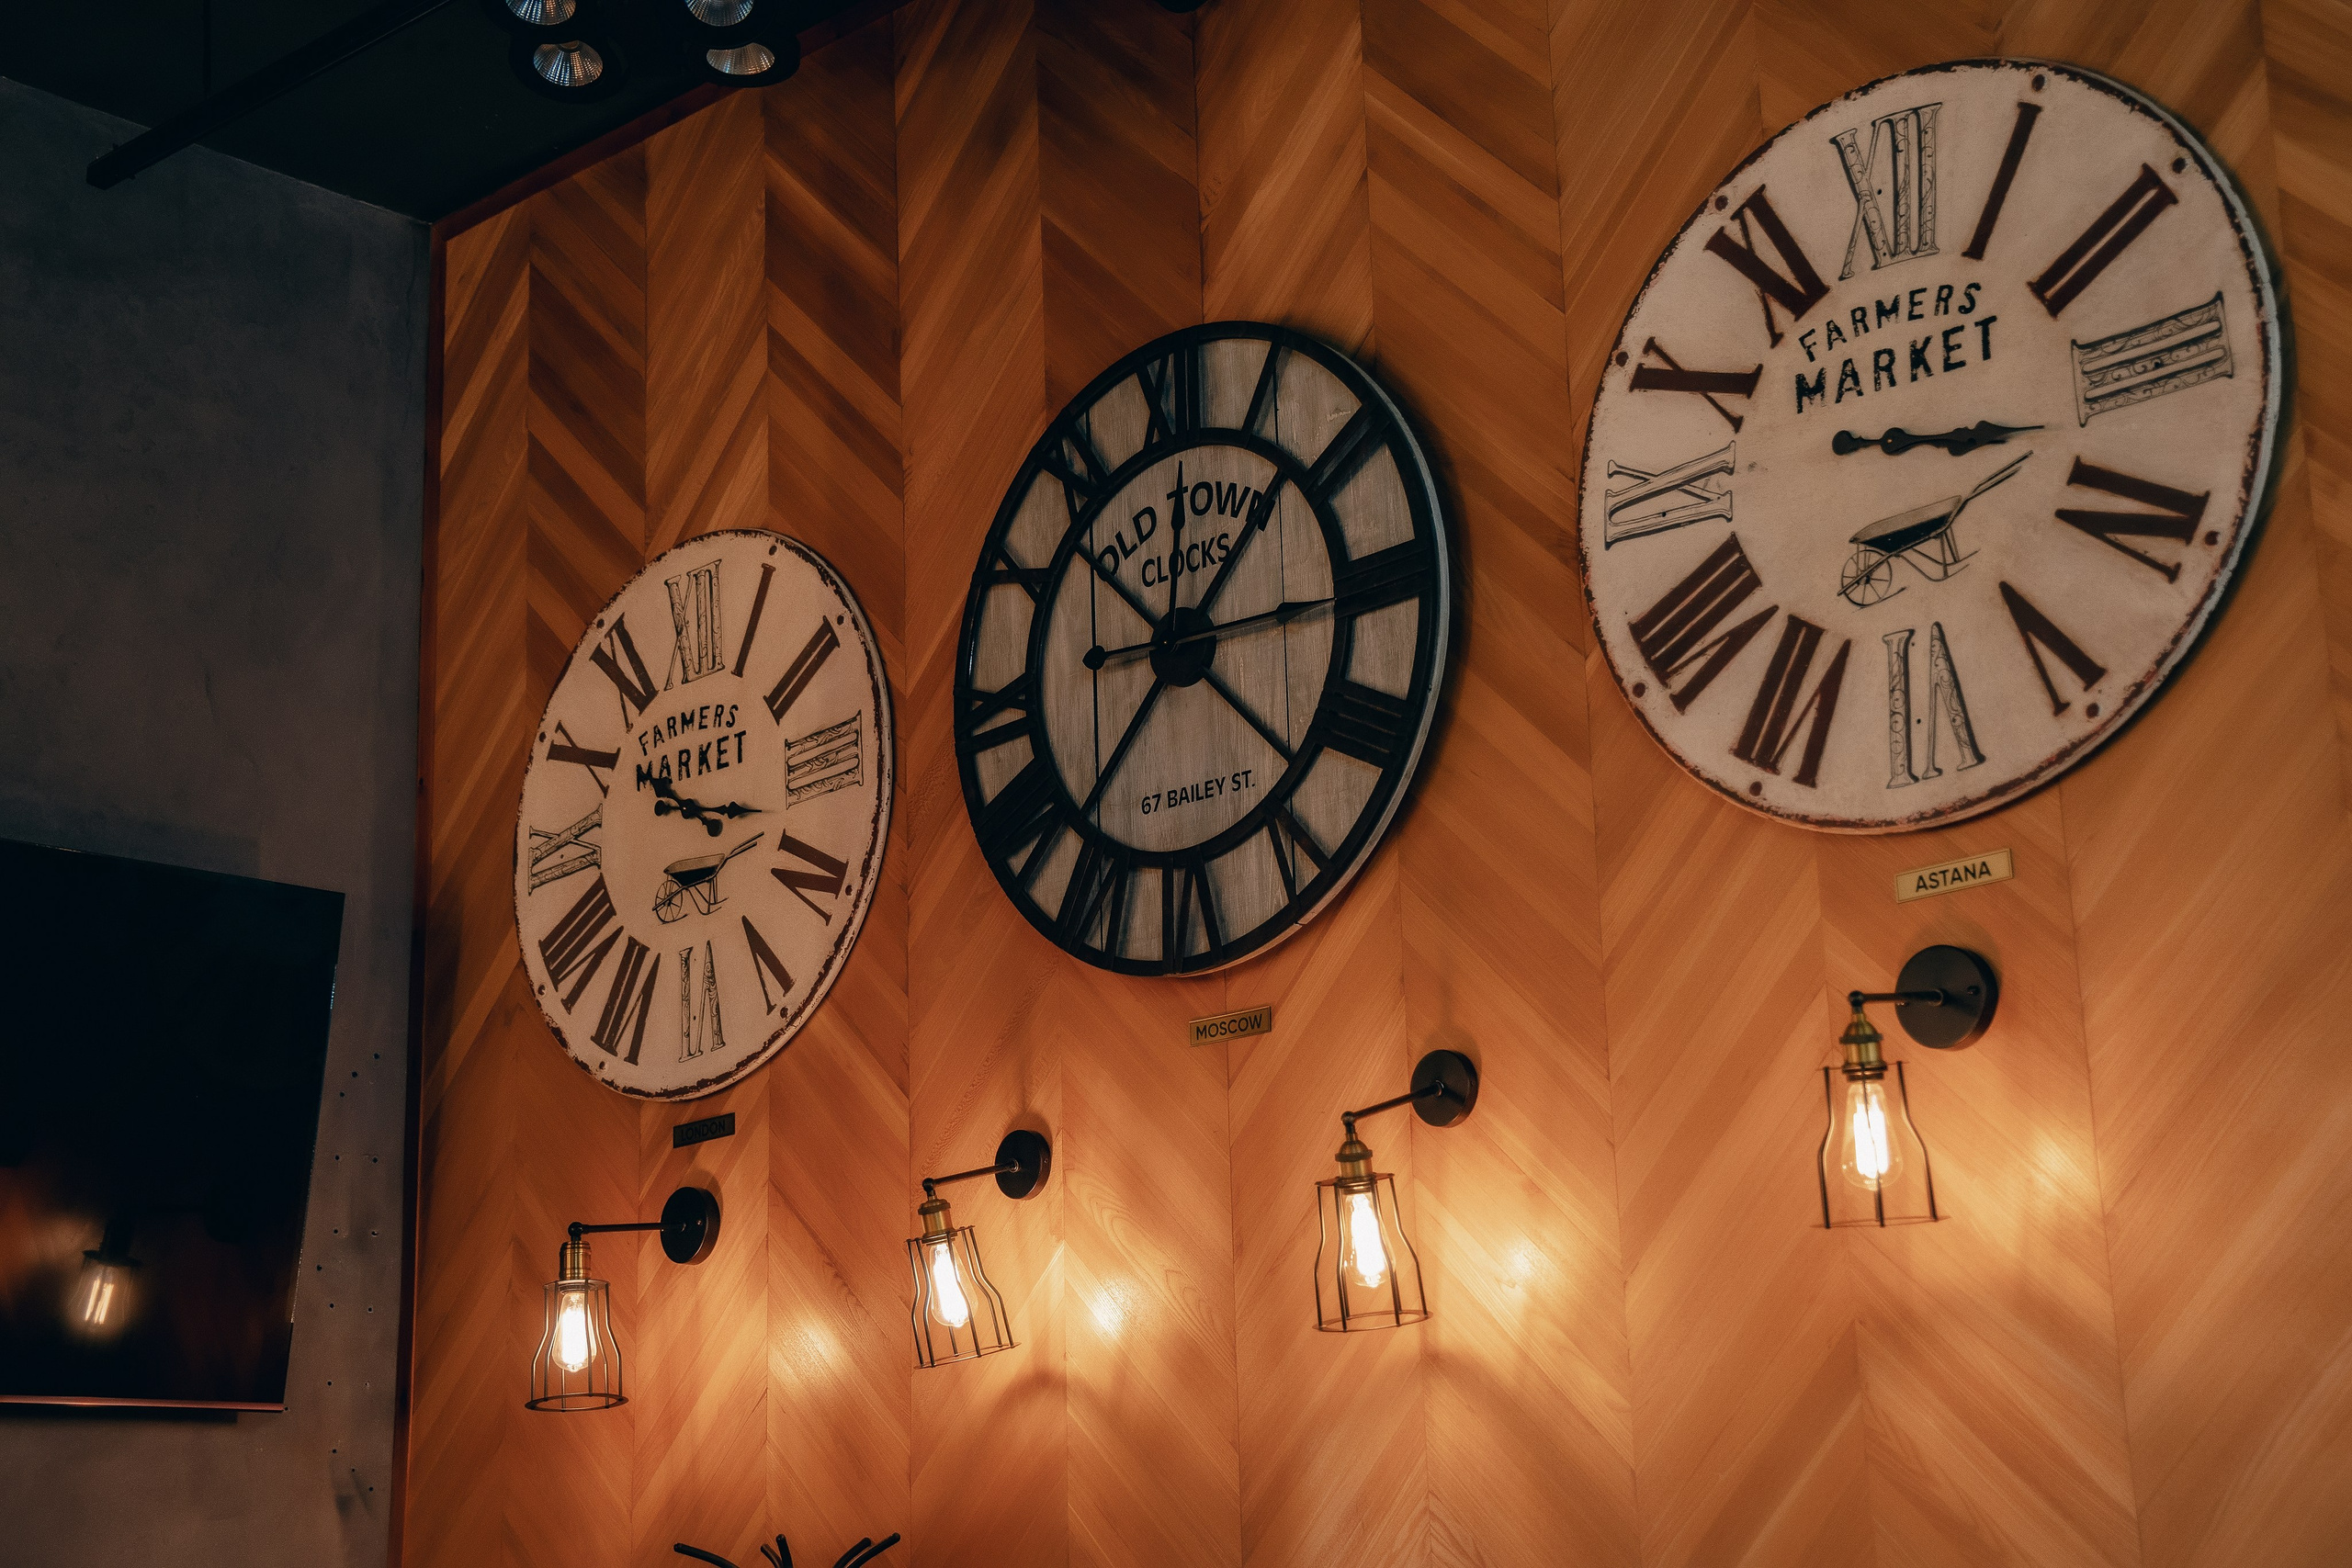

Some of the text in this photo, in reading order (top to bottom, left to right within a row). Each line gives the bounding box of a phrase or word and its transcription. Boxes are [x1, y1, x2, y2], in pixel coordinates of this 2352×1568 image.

[1829, 102, 1943, 281] XII
[1962, 101, 2043, 260] I
[2028, 163, 2179, 318] II
[1794, 315, 1997, 413] MARKET
[1798, 282, 1982, 362] FARMERS
[2070, 291, 2233, 427] III
[1629, 338, 1763, 433] X
[1097, 506, 1157, 581] OLD
[1142, 534, 1232, 587] CLOCKS
[664, 558, 726, 692] XII
[730, 563, 776, 678] I
[1999, 581, 2107, 716] V
[763, 615, 841, 727] II
[1882, 622, 1985, 789] VI
[546, 720, 622, 798] X
[636, 730, 747, 792] MARKET
[638, 704, 739, 756] FARMERS
[785, 709, 864, 810] III
[1141, 769, 1255, 815] 67 BAILEY ST.
[1916, 861, 1992, 893] ASTANA
[678, 940, 726, 1064] VI
[741, 915, 797, 1016] V
[1196, 1013, 1262, 1040] MOSCOW
[681, 1120, 726, 1142] LONDON
